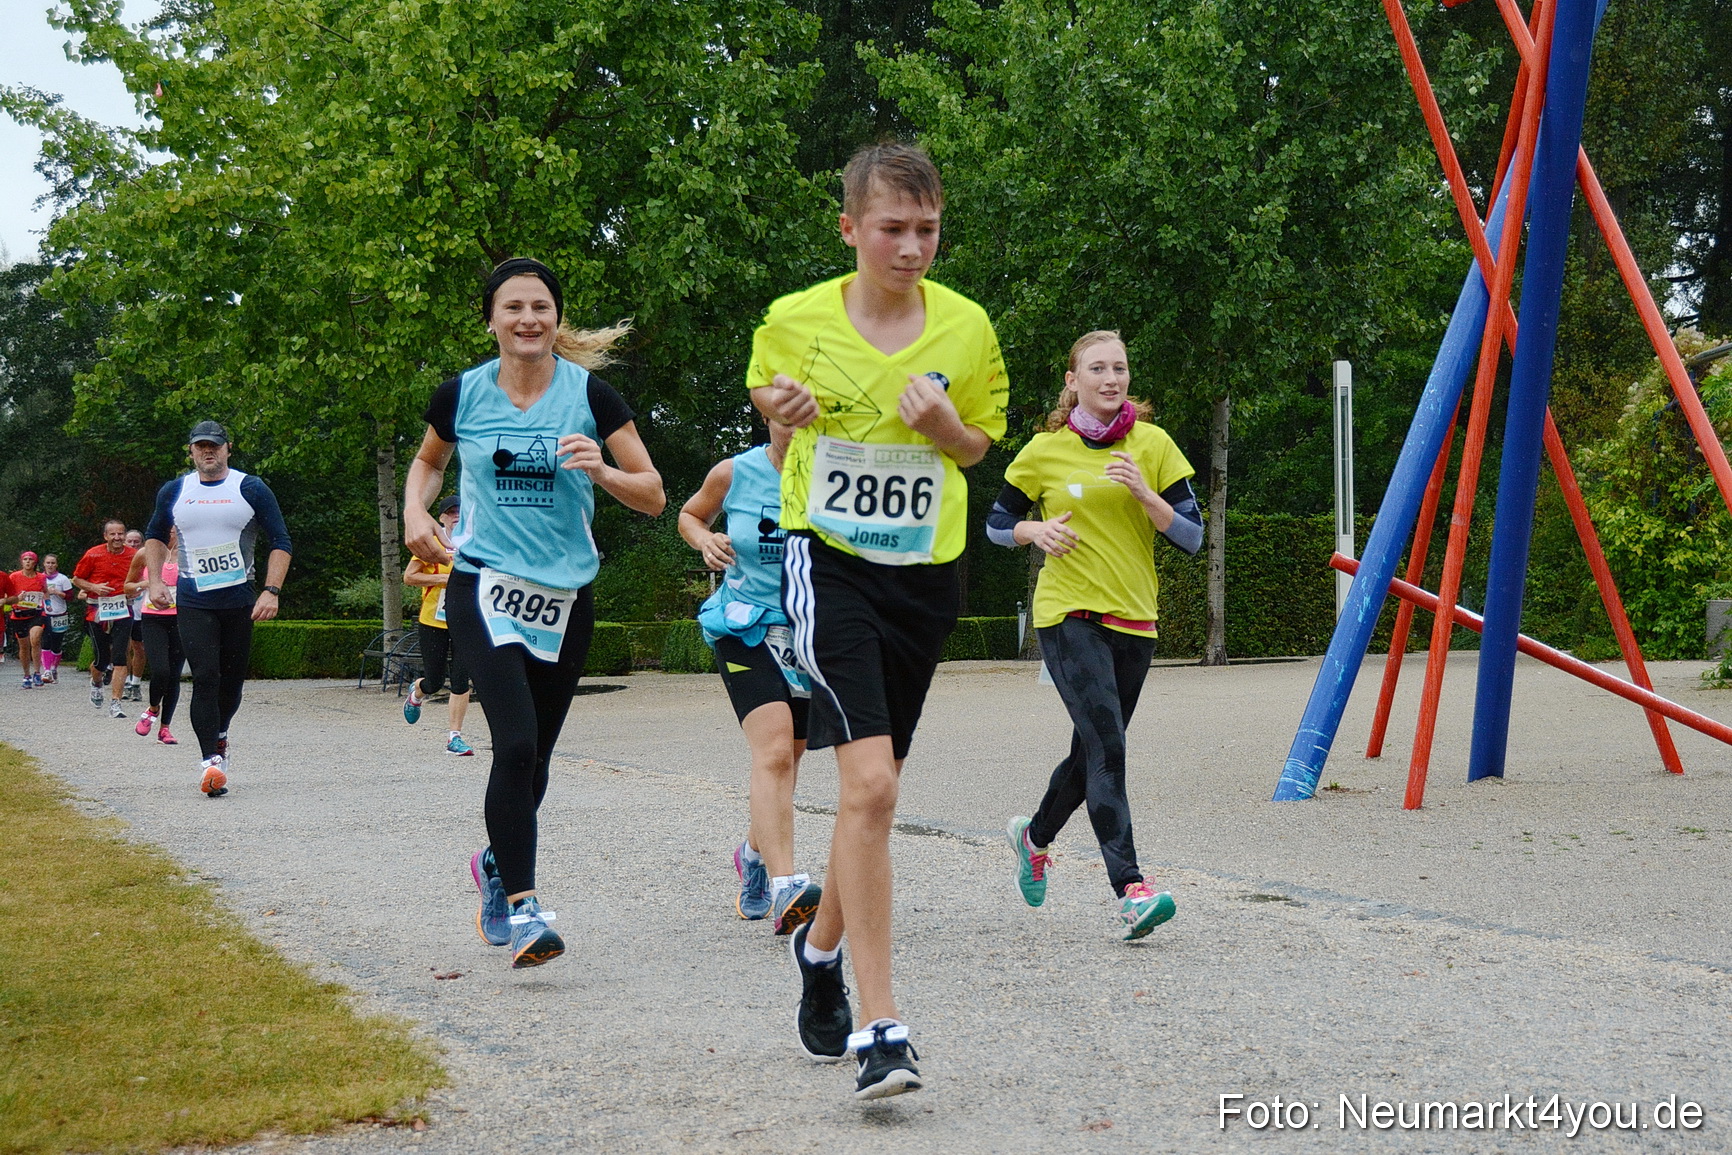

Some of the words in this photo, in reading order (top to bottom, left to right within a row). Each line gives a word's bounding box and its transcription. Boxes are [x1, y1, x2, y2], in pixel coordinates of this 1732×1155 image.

[495, 480, 554, 492] HIRSCH
[497, 496, 554, 504] APOTHEKE
[824, 470, 934, 520] 2866
[850, 526, 900, 548] Jonas
[758, 544, 784, 555] HIR
[198, 552, 240, 574] 3055
[101, 600, 125, 611] 2214
[489, 584, 565, 627] 2895
